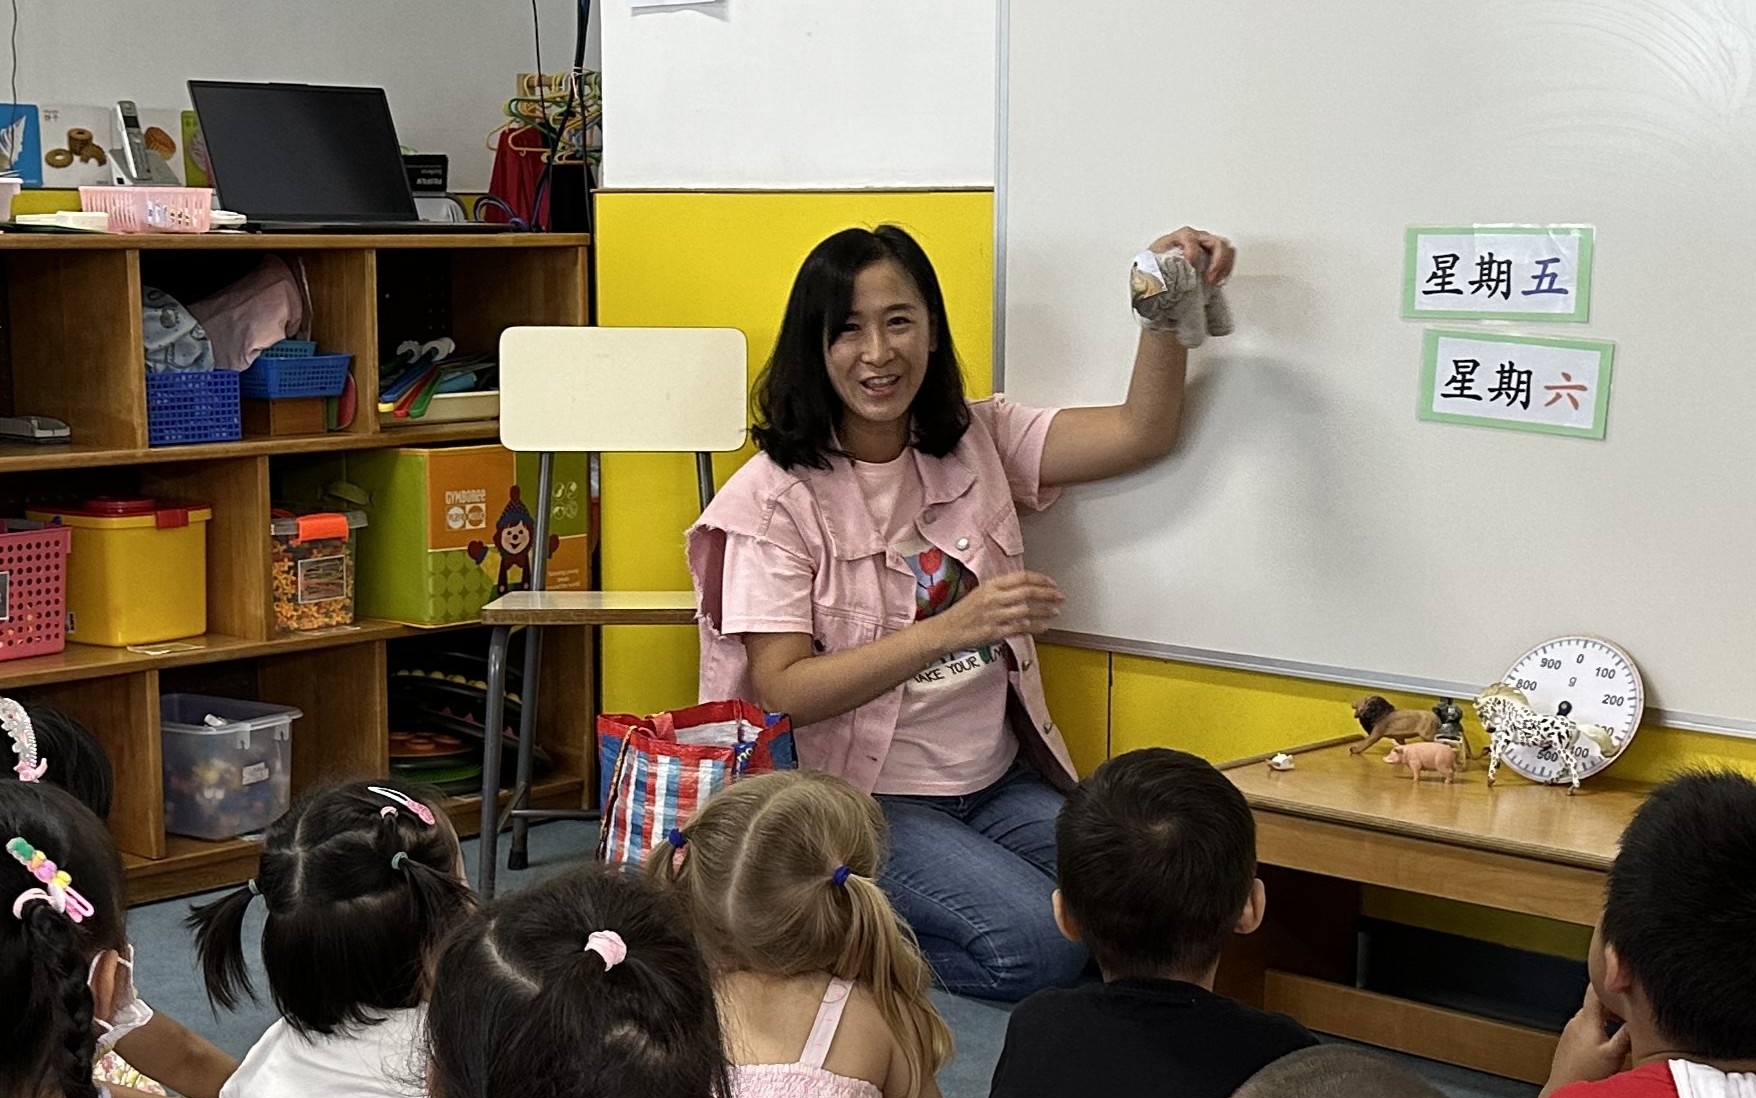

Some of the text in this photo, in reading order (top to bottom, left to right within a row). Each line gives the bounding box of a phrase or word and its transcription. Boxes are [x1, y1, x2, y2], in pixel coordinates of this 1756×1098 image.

[1421, 251, 1569, 301] 星期五
[1440, 358, 1588, 411] 星期六
[1540, 657, 1562, 670] 900
[1576, 653, 1585, 664] 0
[946, 656, 981, 675] YOUR
[1595, 666, 1616, 679] 100
[1516, 679, 1537, 691] 800
[1568, 676, 1577, 687] g
[1602, 694, 1624, 707] 200
[1537, 749, 1559, 762] 500
